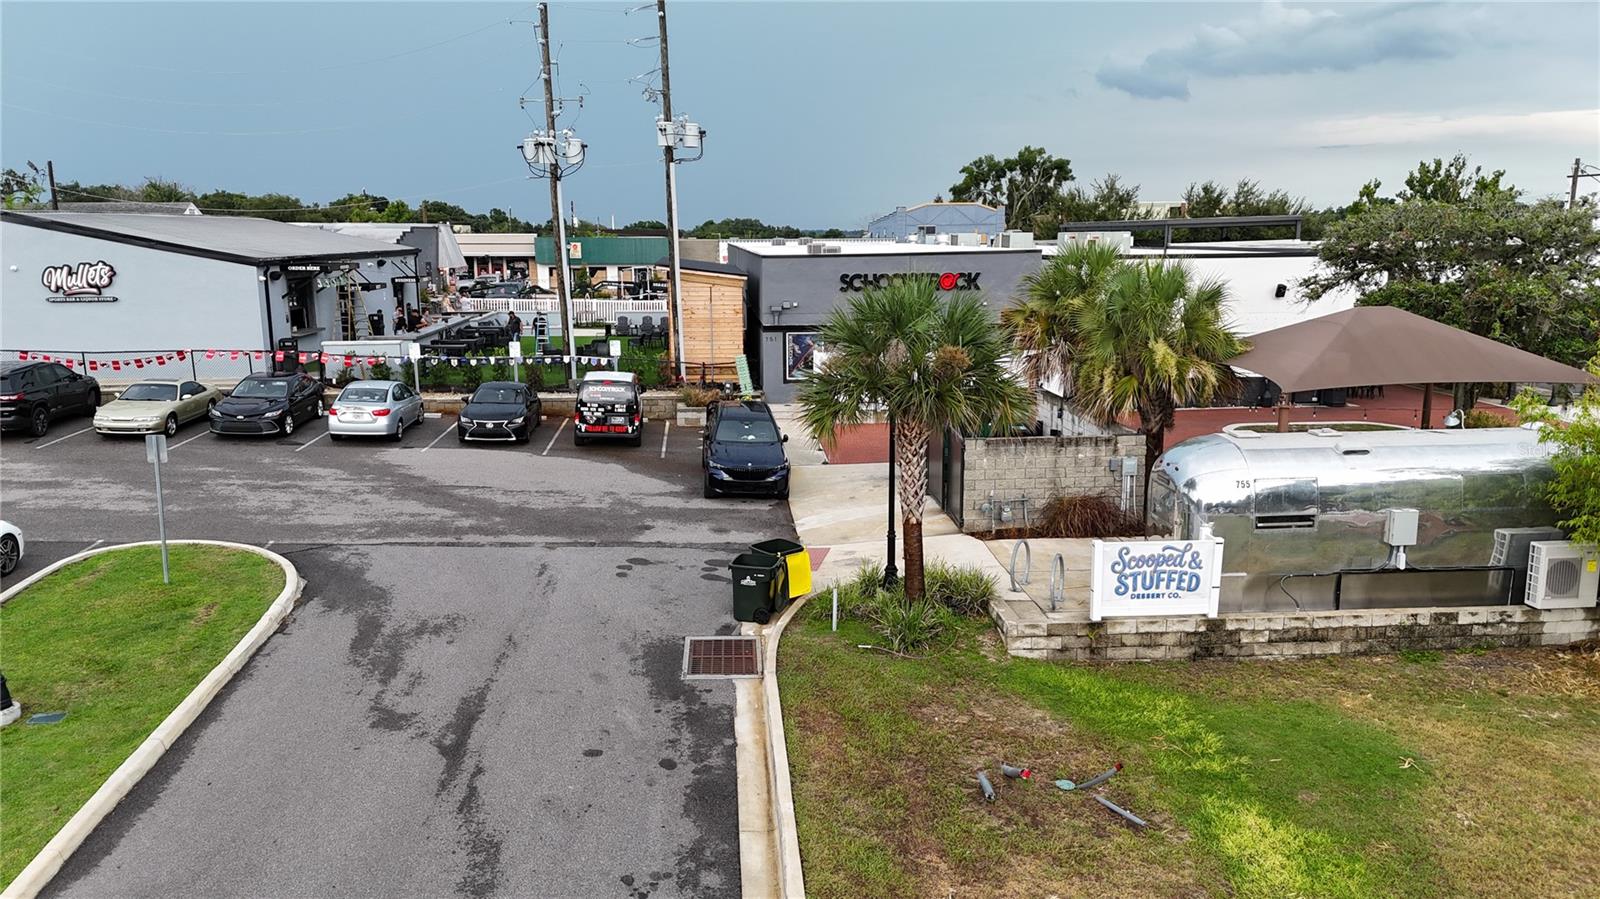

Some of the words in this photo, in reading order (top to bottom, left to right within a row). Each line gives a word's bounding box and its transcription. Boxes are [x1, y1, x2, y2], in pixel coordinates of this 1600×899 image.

[42, 261, 115, 293] Mullets
[1236, 480, 1251, 489] 755
[1111, 542, 1193, 574] Scooped
[1188, 550, 1203, 570] &
[1114, 569, 1201, 596] STUFFED
[1130, 592, 1166, 600] DESSERT
